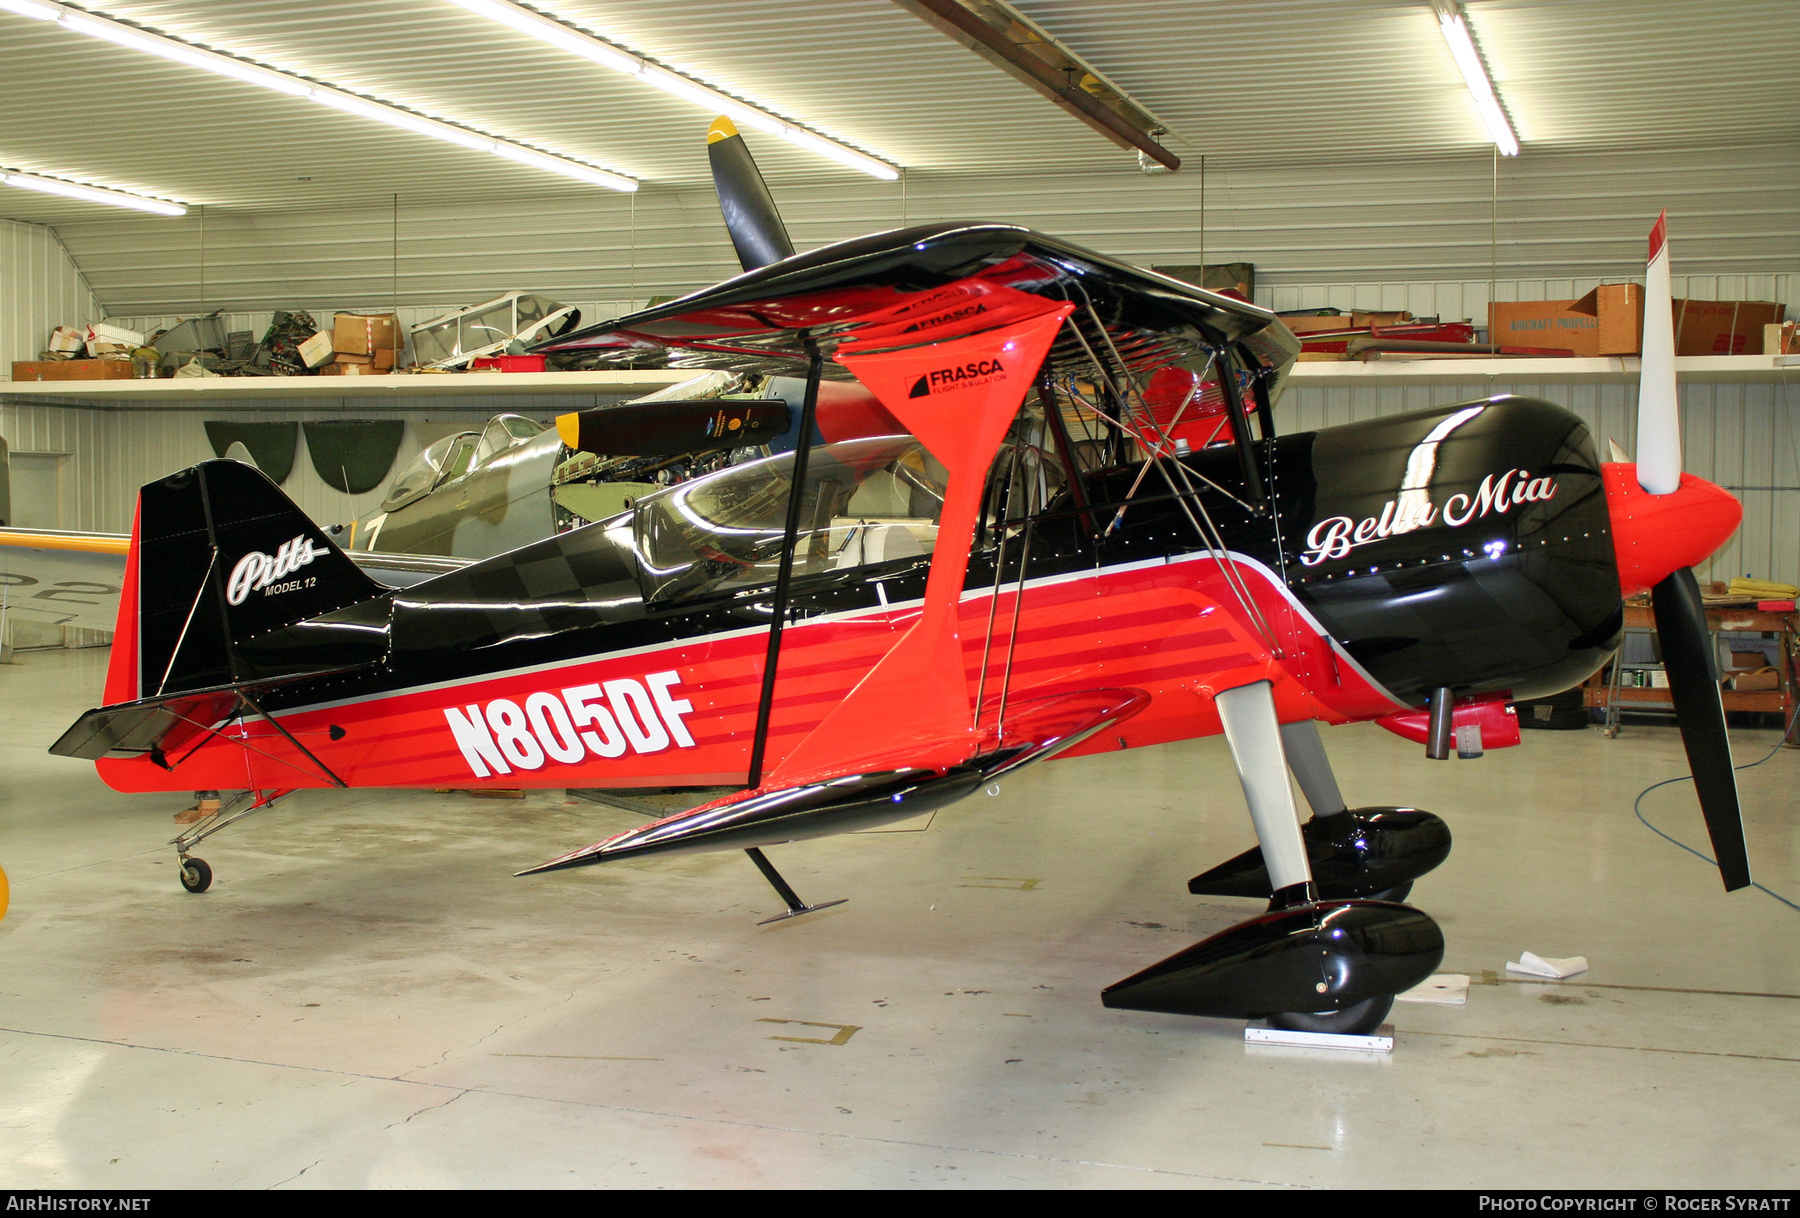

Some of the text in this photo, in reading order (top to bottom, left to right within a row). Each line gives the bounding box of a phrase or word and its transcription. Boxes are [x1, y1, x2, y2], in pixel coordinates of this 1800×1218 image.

[1510, 319, 1552, 331] AIRCRAFT
[930, 359, 1004, 386] FRASCA
[933, 374, 1007, 394] FLIGHT SIMULATION
[1300, 468, 1558, 567] Bella Mia
[226, 533, 331, 606] Pitts
[264, 577, 317, 596] MODEL 12
[443, 670, 696, 778] N805DF
